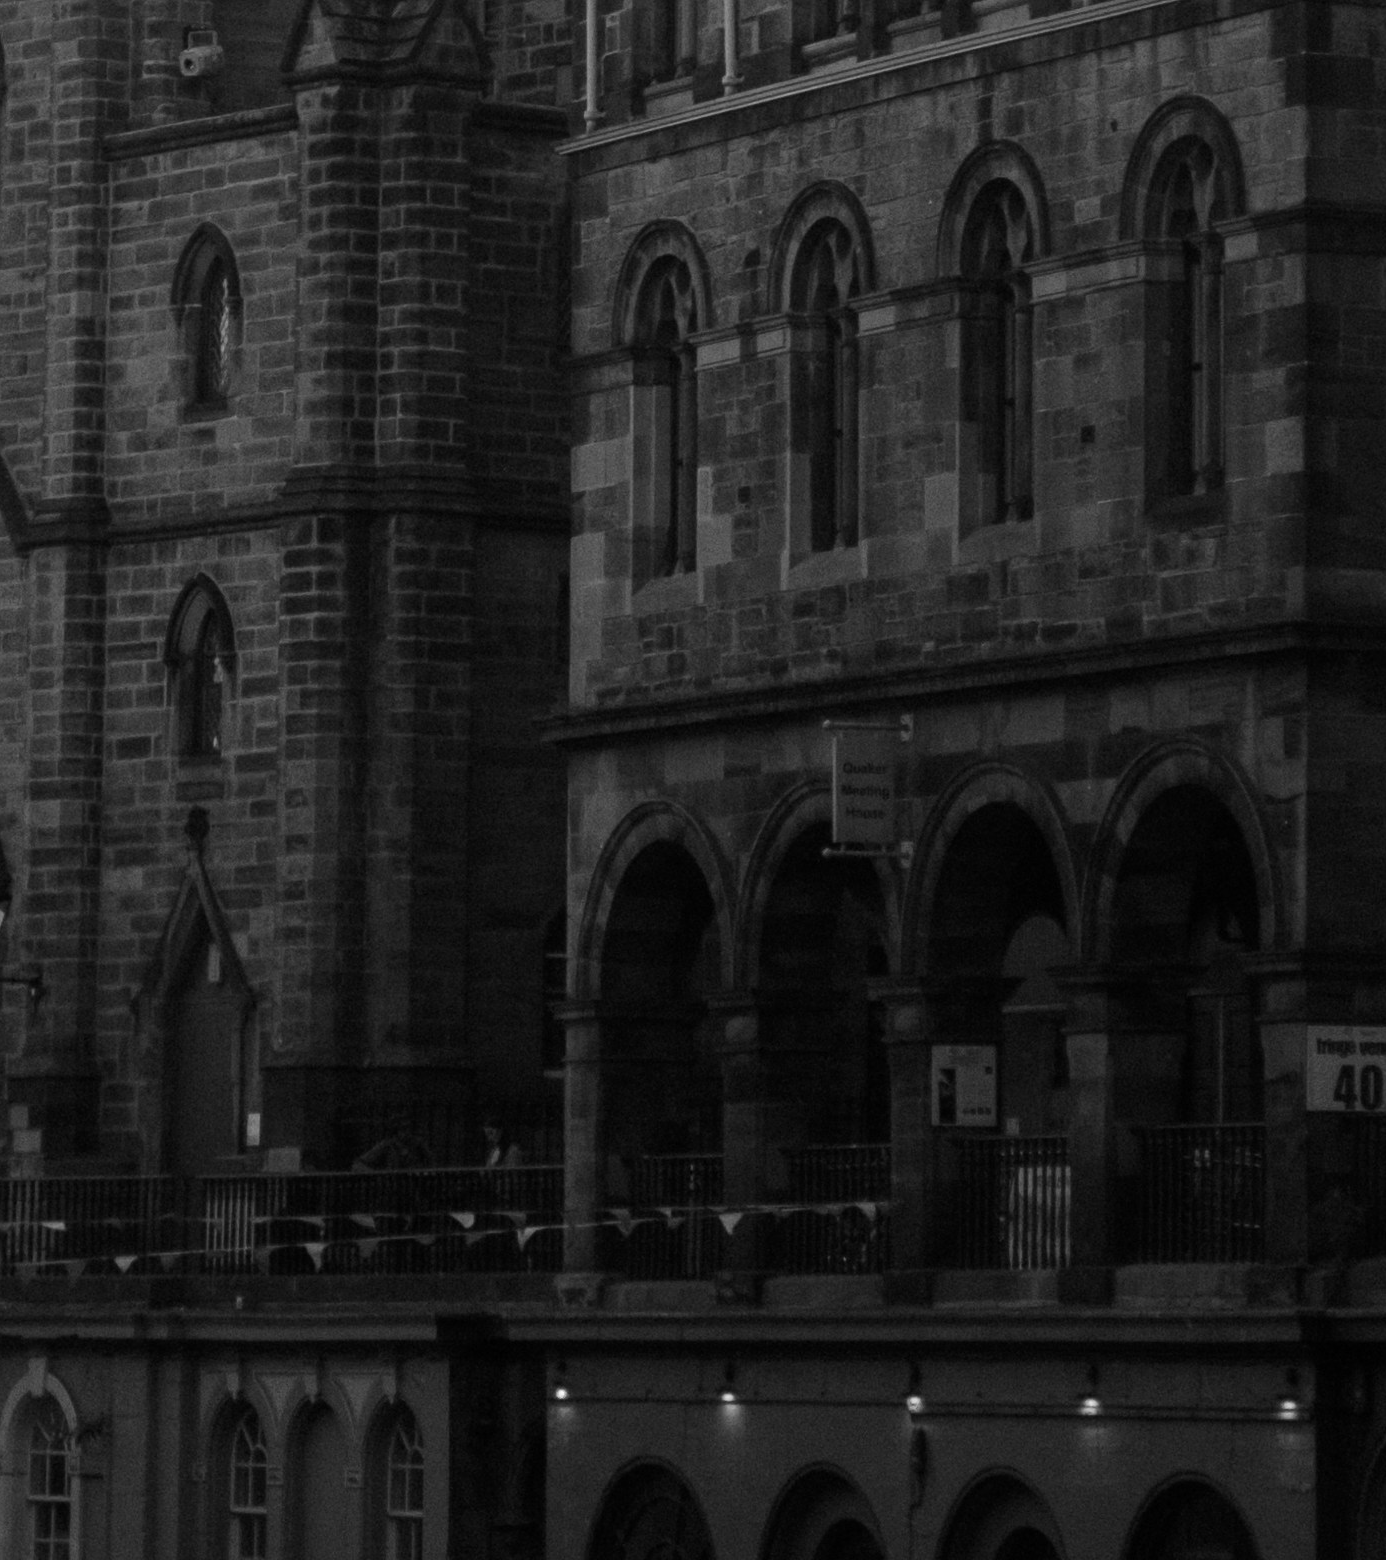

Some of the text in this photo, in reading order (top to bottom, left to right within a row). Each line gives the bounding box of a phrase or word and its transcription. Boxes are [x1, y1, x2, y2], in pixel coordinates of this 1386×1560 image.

[842, 762, 887, 774] Quaker
[841, 784, 890, 801] Meeting
[845, 807, 886, 819] House
[1333, 1064, 1384, 1110] 40
